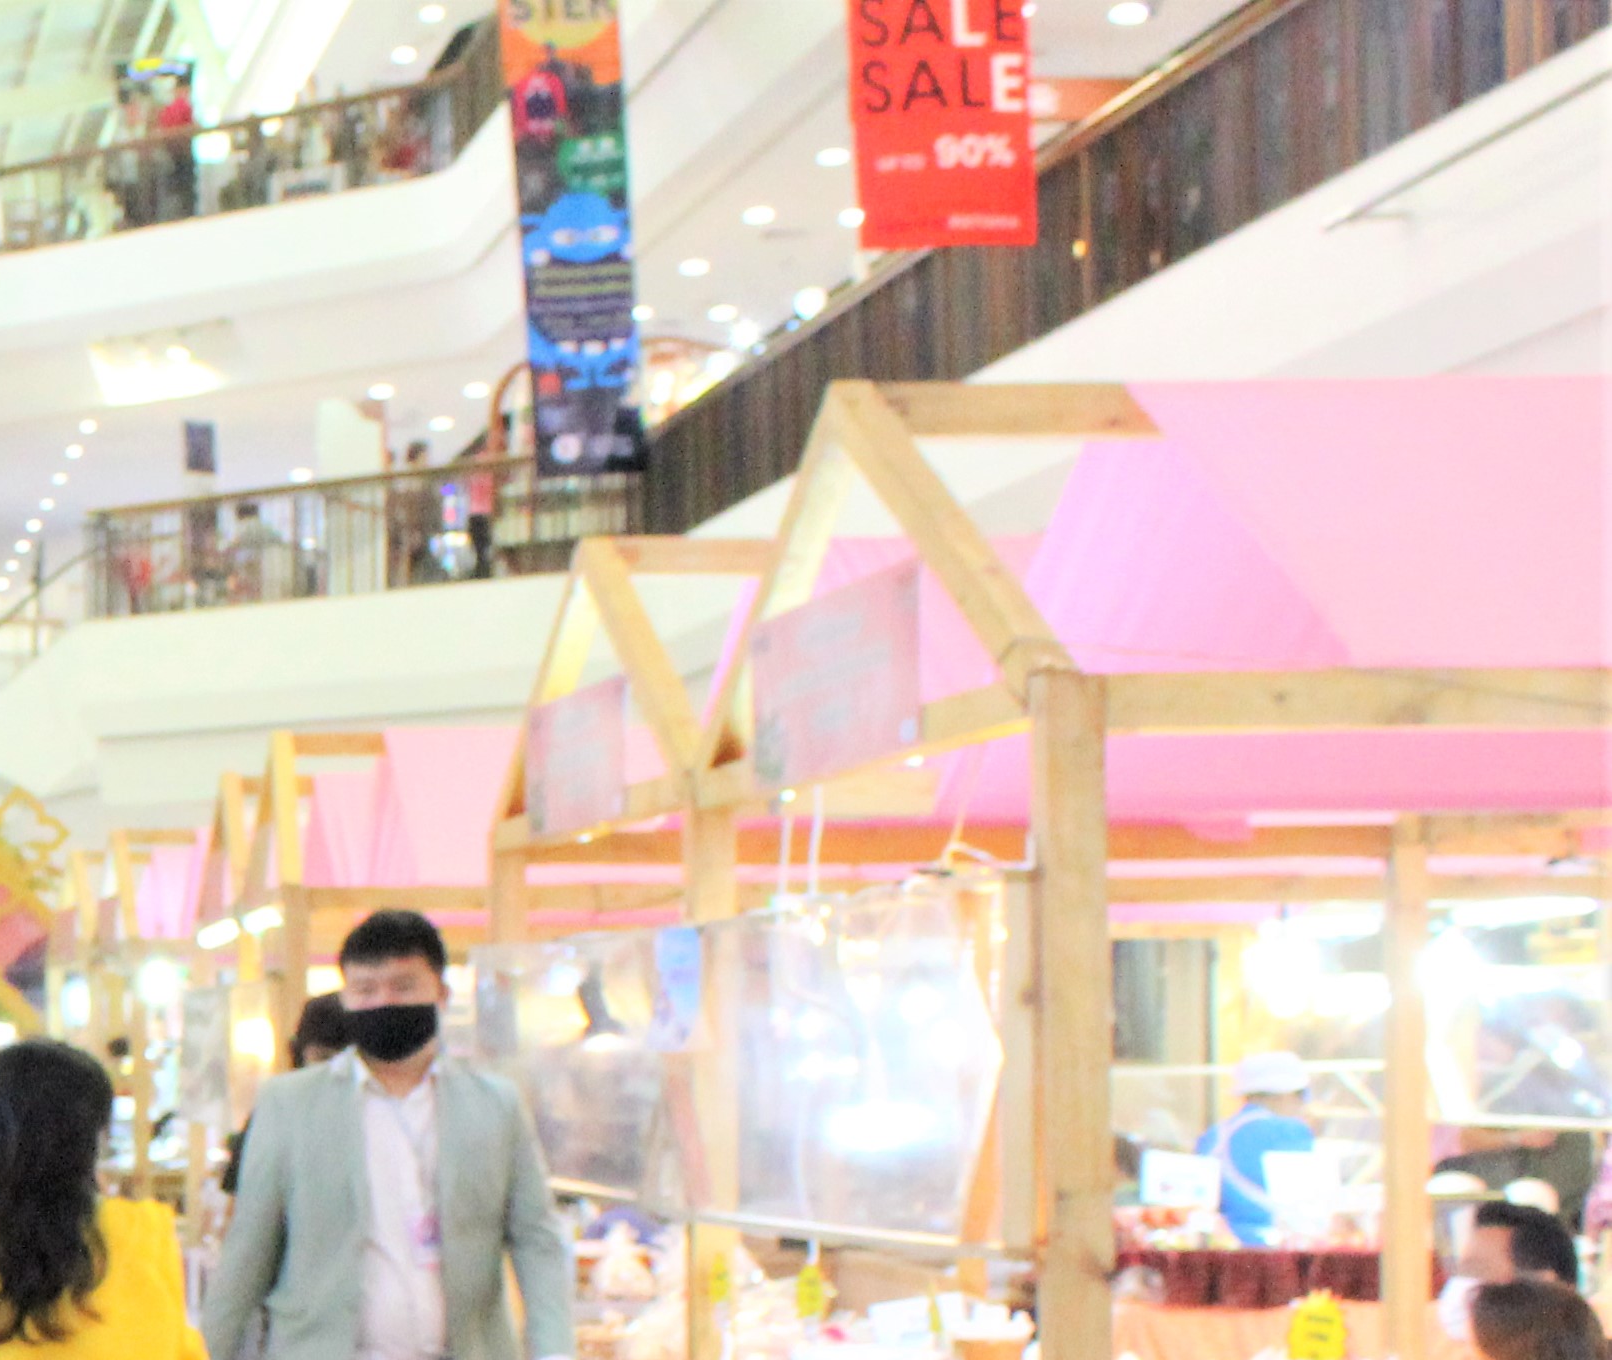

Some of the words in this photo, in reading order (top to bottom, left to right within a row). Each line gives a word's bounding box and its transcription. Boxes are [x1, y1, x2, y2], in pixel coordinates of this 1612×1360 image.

[860, 0, 1020, 47] SALE
[863, 54, 1023, 113] SALE
[934, 133, 1016, 169] 90%
